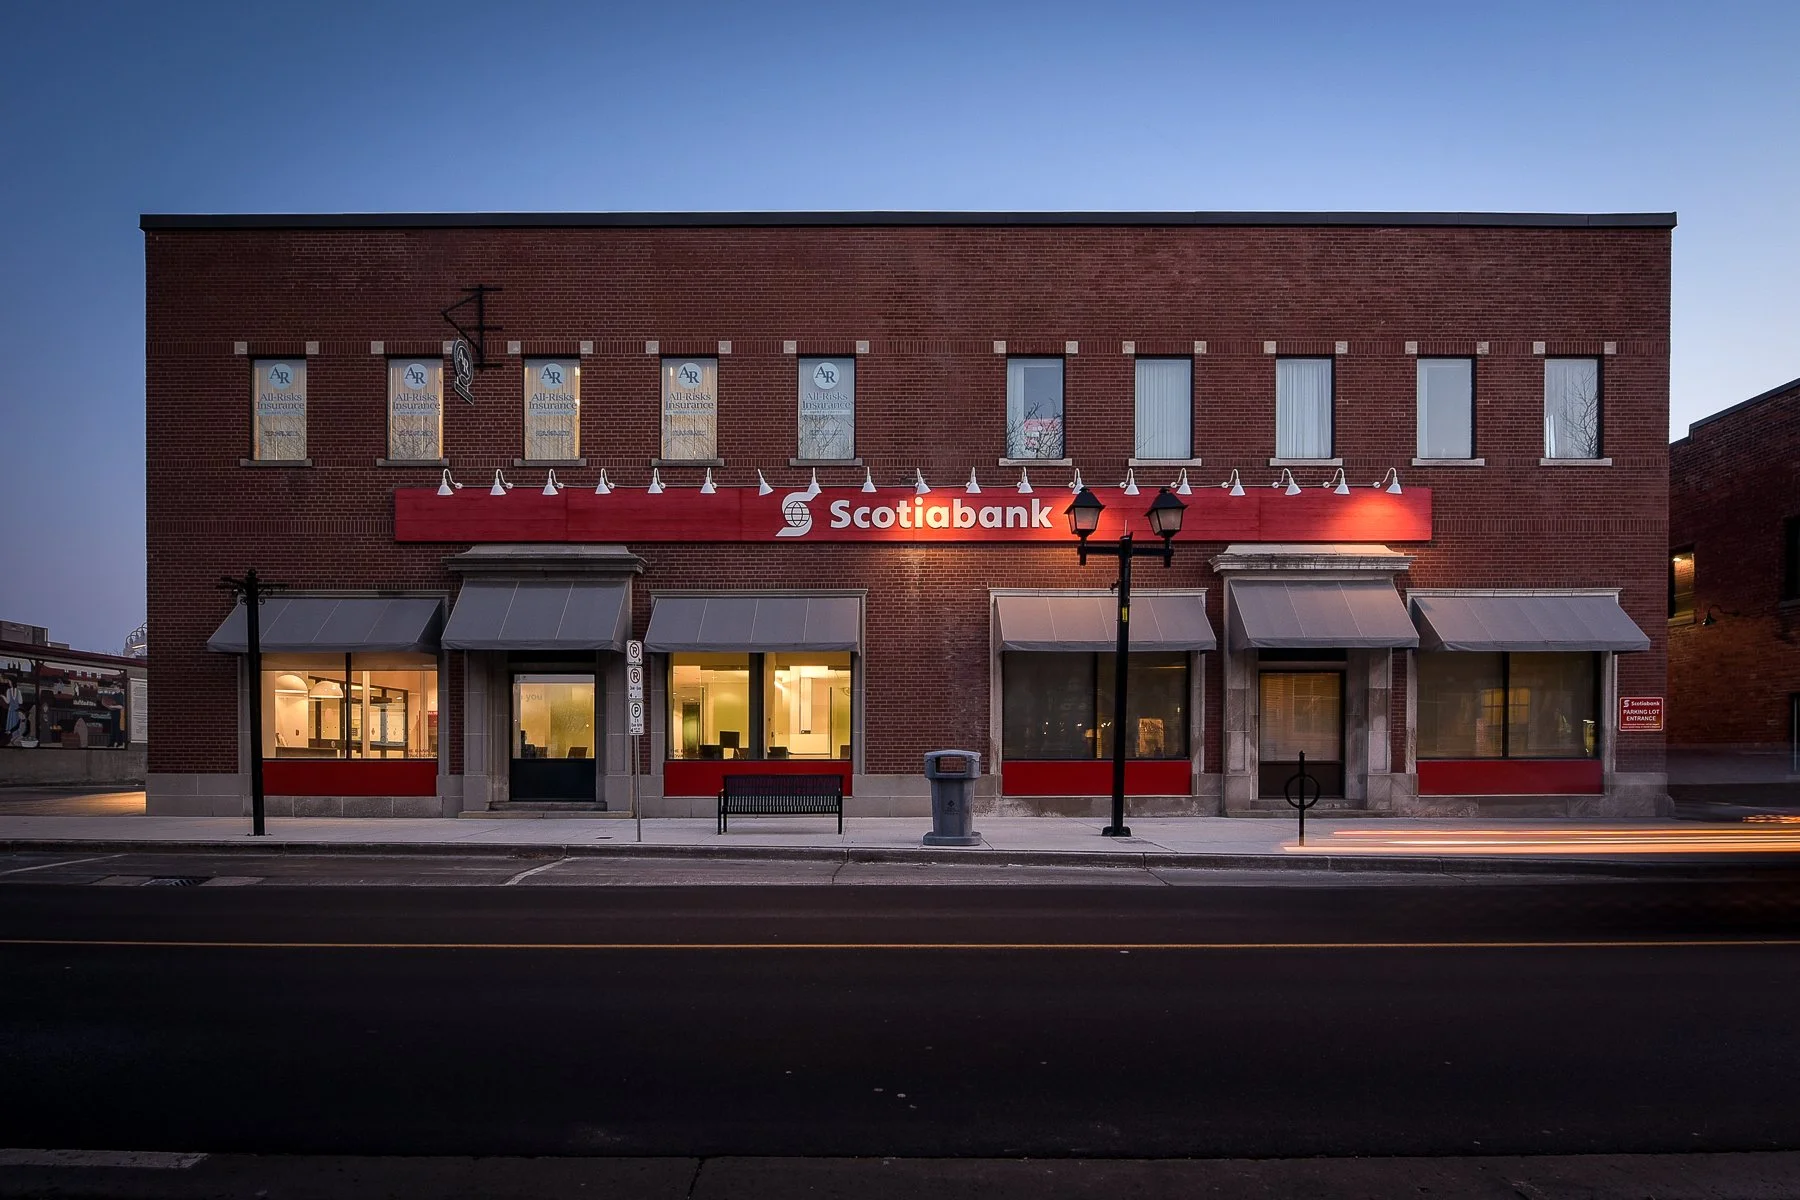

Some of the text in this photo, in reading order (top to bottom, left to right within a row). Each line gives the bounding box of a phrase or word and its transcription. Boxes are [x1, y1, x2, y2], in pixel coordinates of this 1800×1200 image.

[269, 366, 290, 384] AR
[405, 366, 426, 384] AR
[541, 366, 562, 384] AR
[678, 366, 699, 384] AR
[815, 366, 836, 383] AR
[260, 392, 302, 401] All-Risks
[395, 392, 438, 401] All-Risks
[531, 392, 575, 401] All-Risks
[669, 392, 712, 401] All-Risks
[806, 392, 848, 400] All-Risks
[257, 401, 305, 410] Insurance
[393, 401, 441, 410] Insurance
[528, 401, 577, 410] Insurance
[666, 400, 714, 409] Insurance
[802, 400, 851, 410] Insurance
[830, 496, 1053, 529] Scotiabank
[526, 694, 543, 702] you
